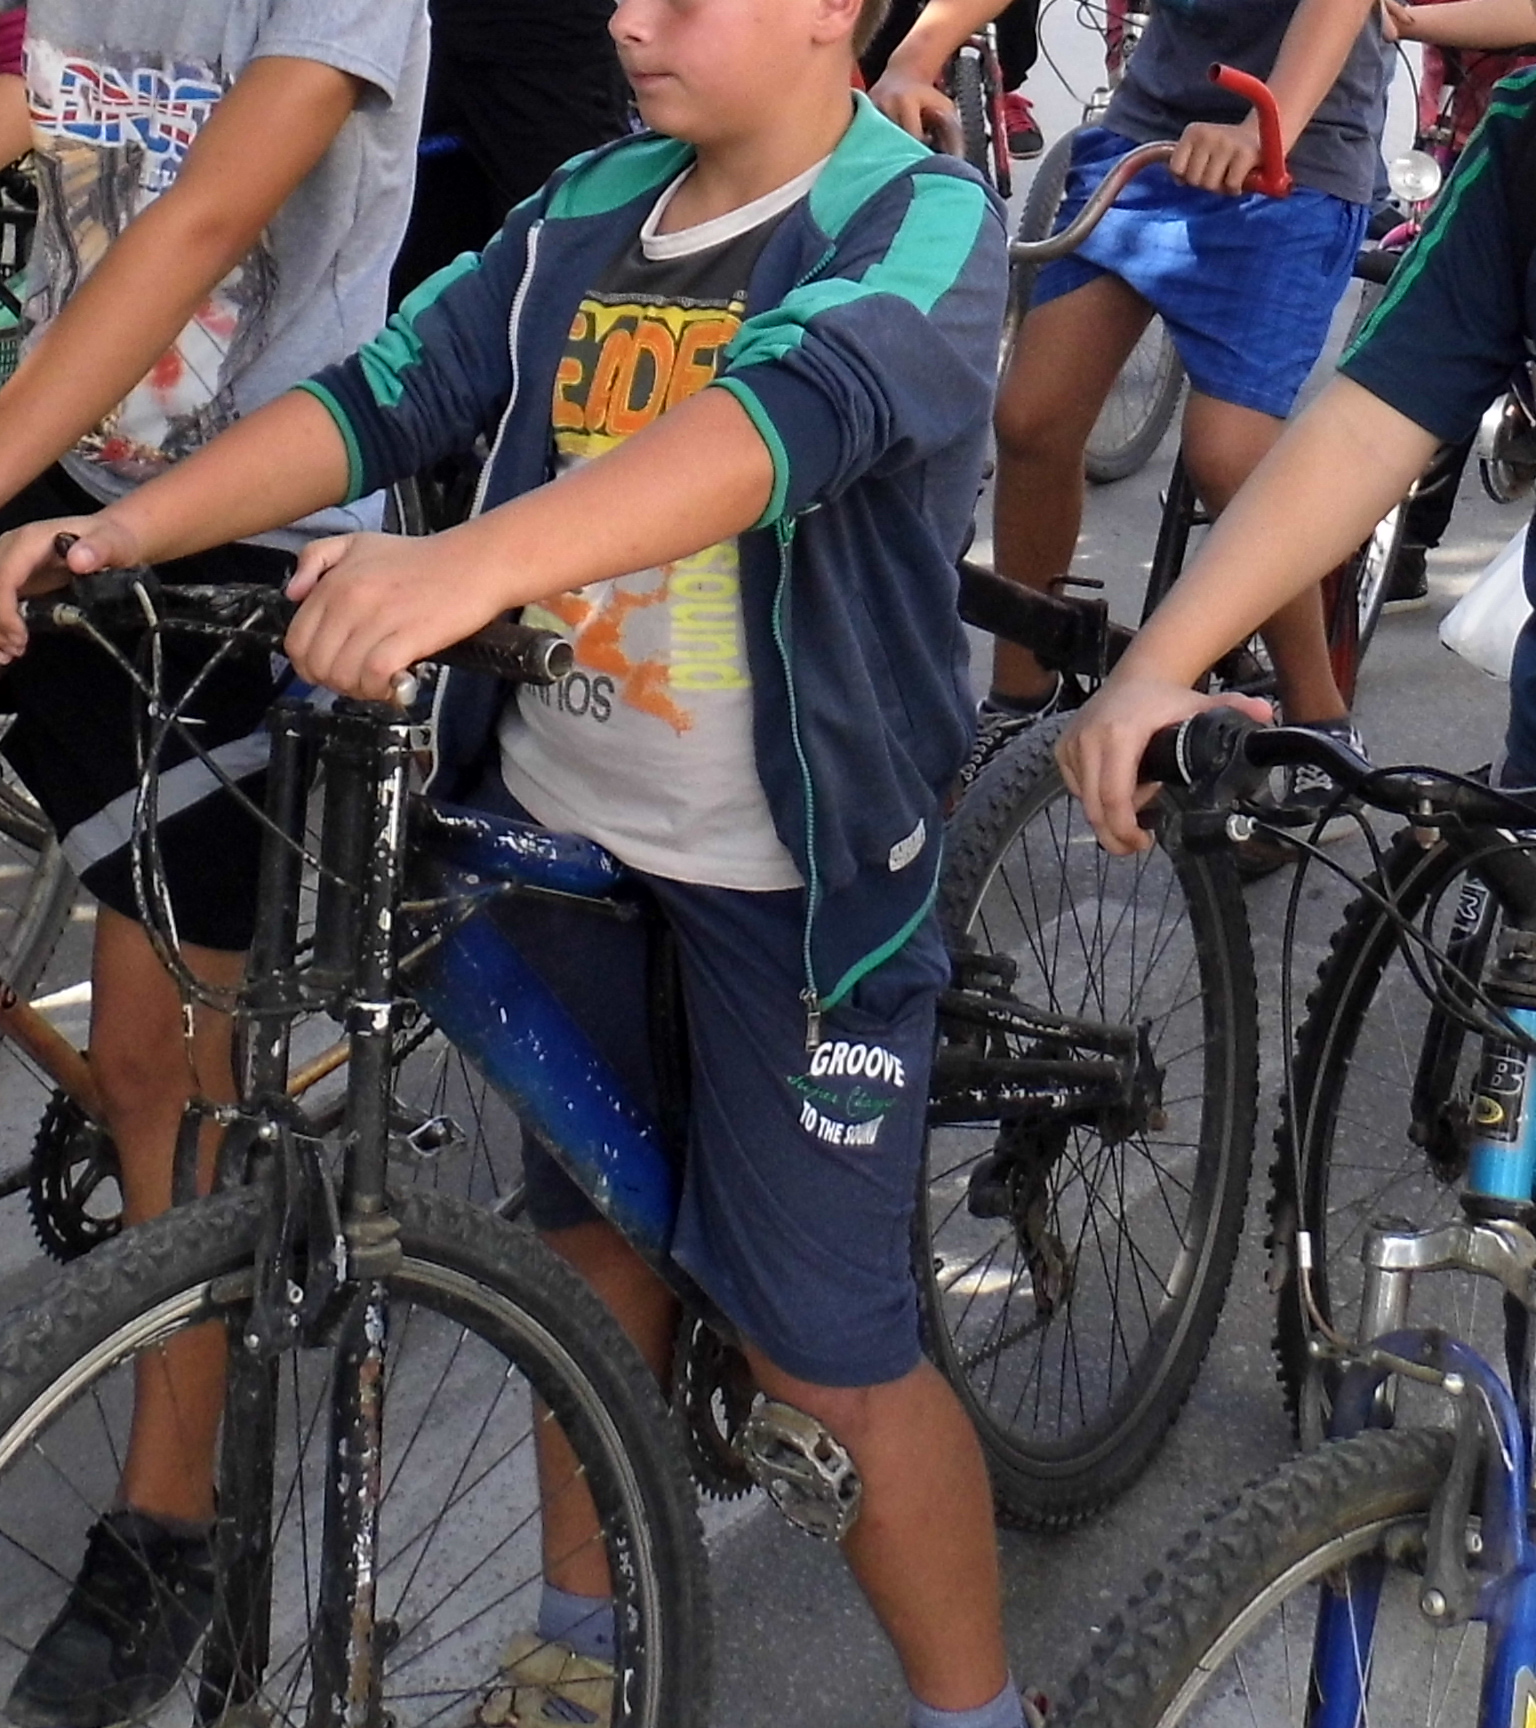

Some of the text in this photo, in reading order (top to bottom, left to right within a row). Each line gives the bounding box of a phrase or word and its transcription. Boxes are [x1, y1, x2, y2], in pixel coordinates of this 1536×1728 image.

[810, 1041, 905, 1088] GROOVE
[799, 1100, 817, 1132] TO
[817, 1116, 844, 1144] THE
